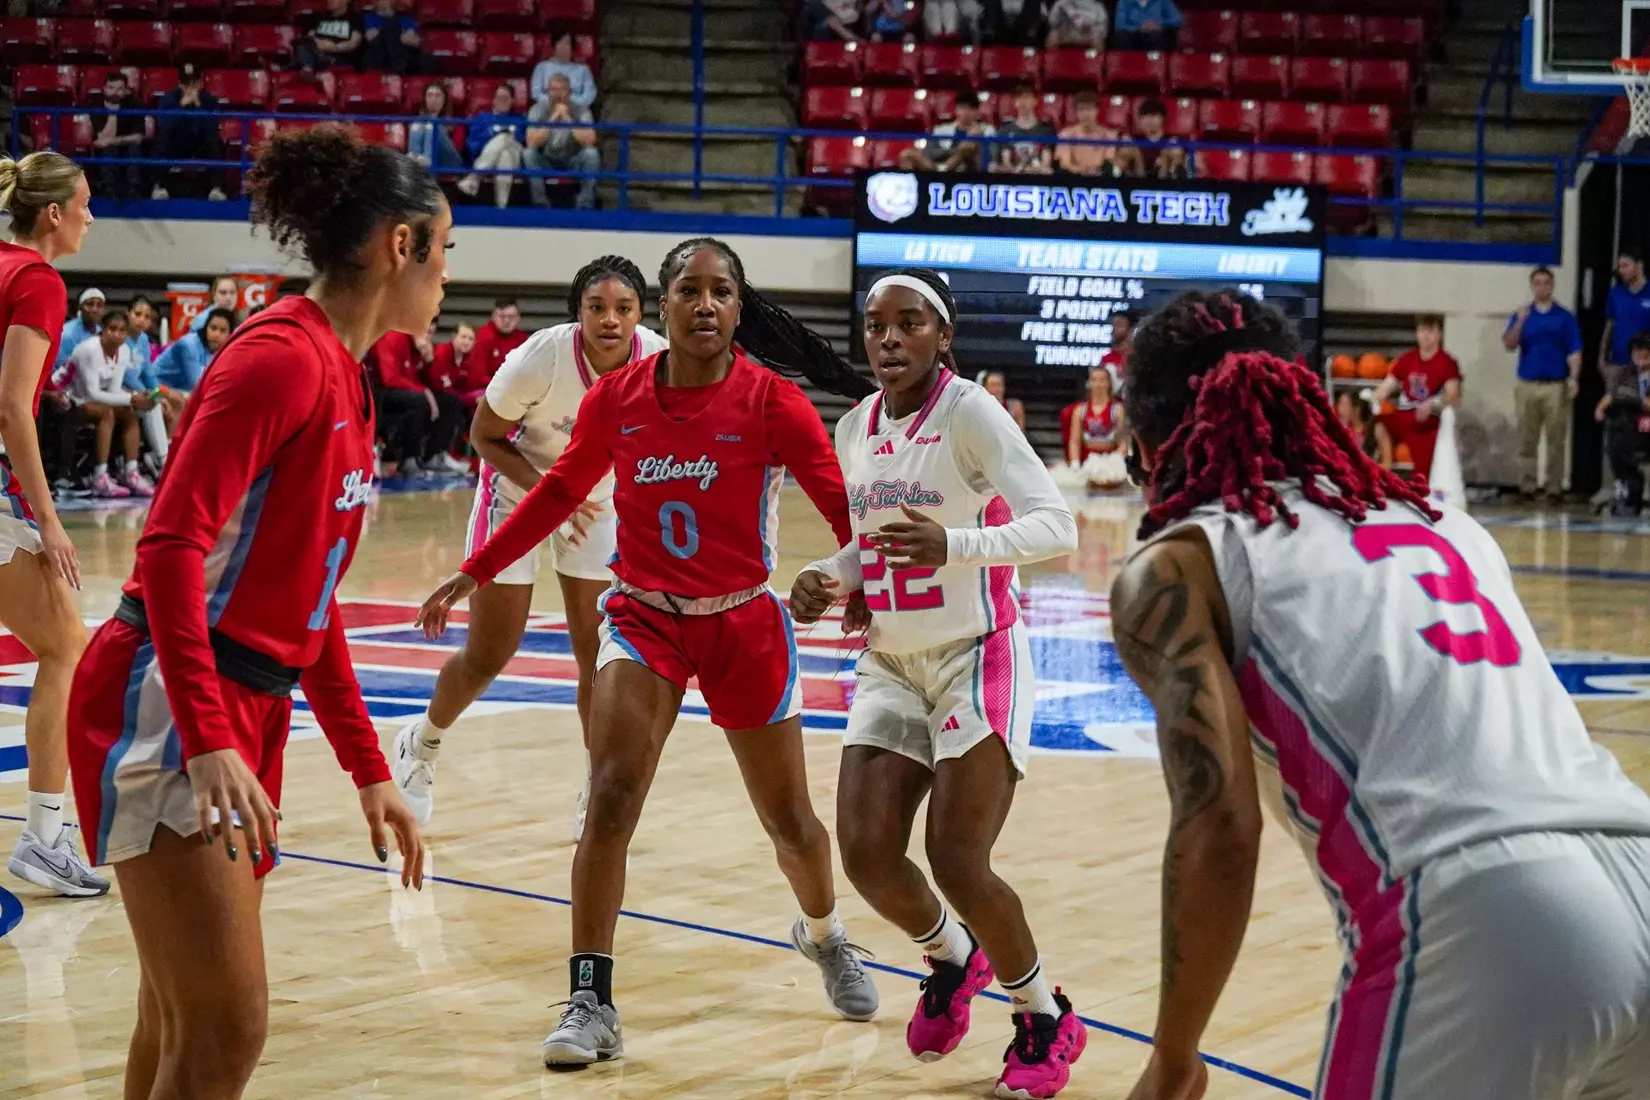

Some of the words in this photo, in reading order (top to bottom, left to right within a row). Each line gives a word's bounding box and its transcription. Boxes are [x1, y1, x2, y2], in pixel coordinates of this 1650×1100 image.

[928, 182, 1128, 223] LOUISIANA
[1130, 189, 1231, 226] TECH
[1017, 243, 1083, 270] TEAM
[1085, 246, 1158, 273] STATS
[1027, 275, 1079, 297] FIELD
[1080, 277, 1124, 299] GOAL
[1055, 299, 1112, 321] POINT
[1020, 321, 1066, 342] FREE
[633, 453, 719, 492] Liberty
[658, 500, 700, 560] 0
[307, 536, 348, 631] 1
[1350, 523, 1522, 668] 3
